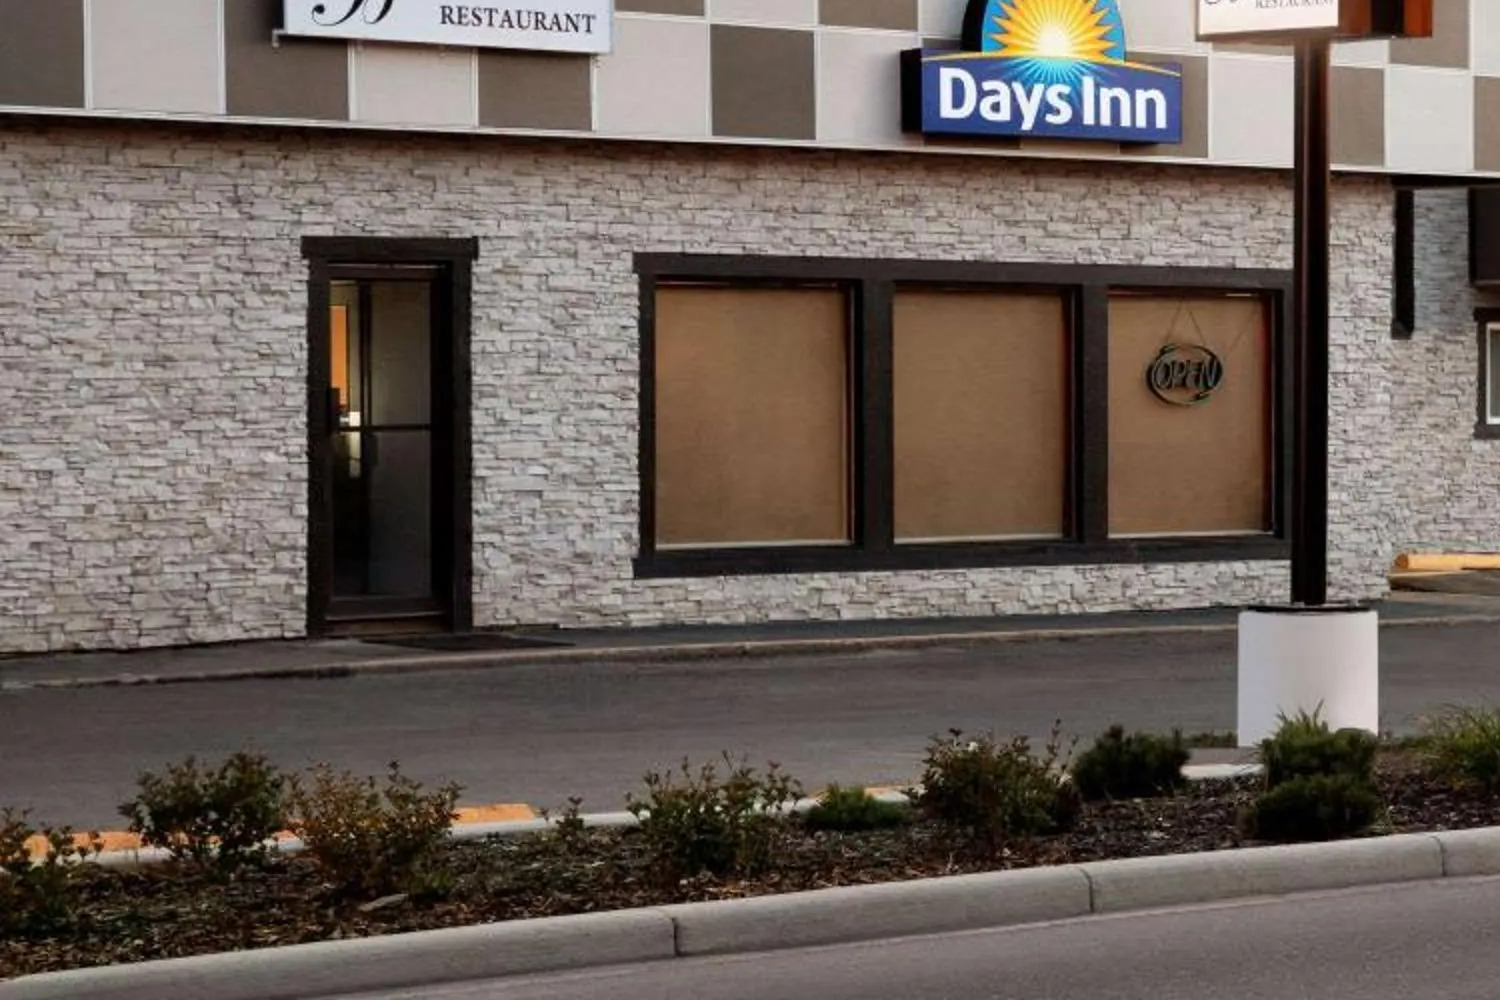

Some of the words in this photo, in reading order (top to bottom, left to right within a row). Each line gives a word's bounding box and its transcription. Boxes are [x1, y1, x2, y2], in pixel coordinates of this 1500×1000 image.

[440, 5, 596, 33] RESTAURANT
[939, 67, 1072, 131] Days
[1082, 76, 1167, 129] Inn
[1154, 359, 1220, 391] OPEN
